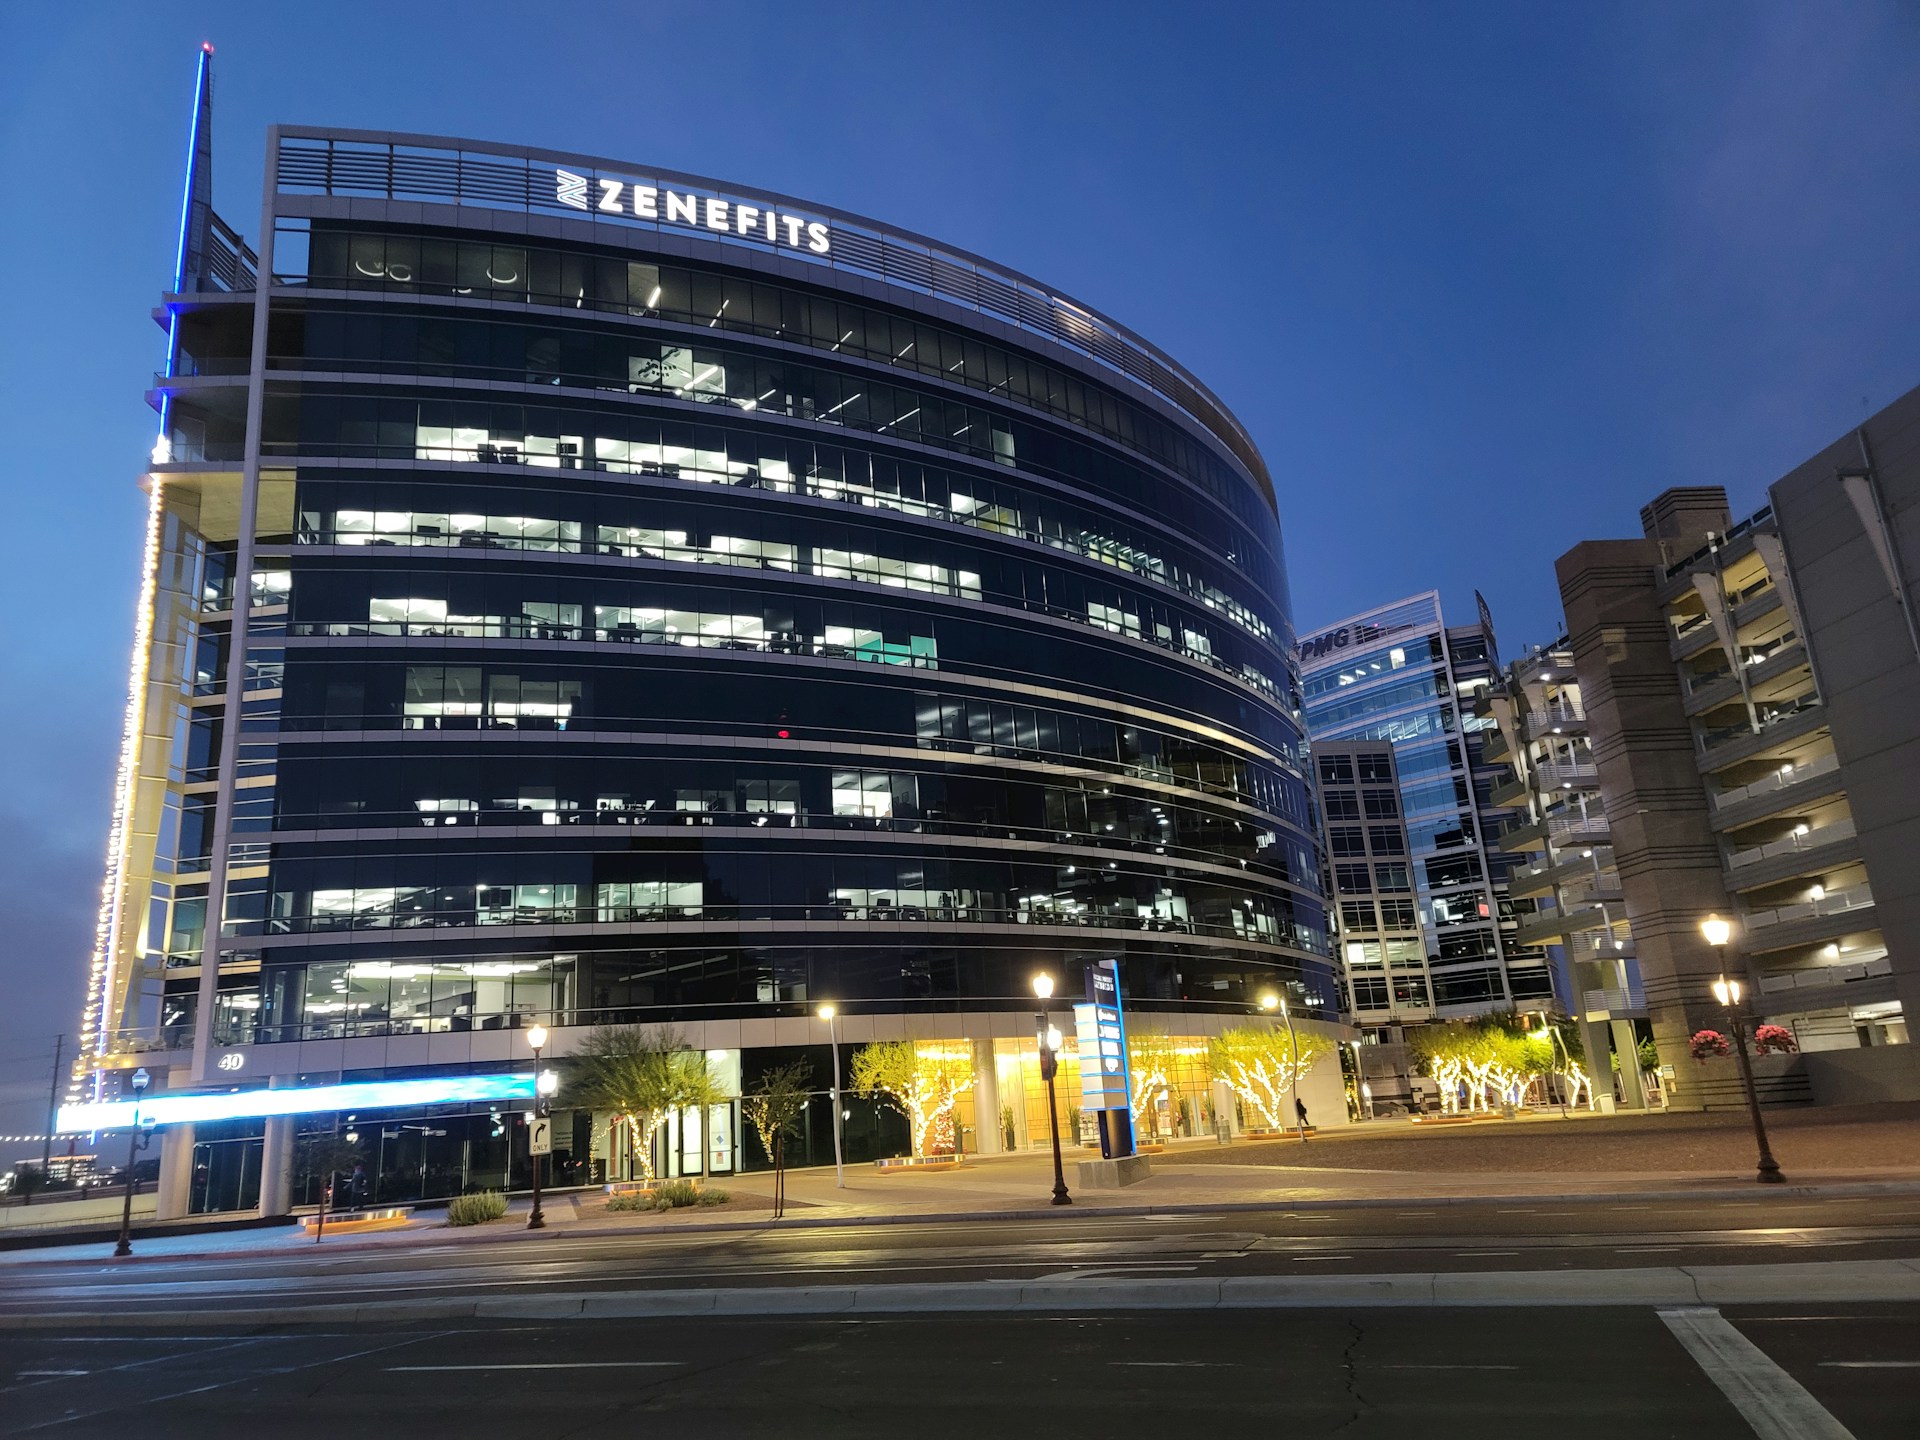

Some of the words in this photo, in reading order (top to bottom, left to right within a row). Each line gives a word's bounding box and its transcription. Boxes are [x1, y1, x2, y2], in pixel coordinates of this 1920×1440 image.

[598, 179, 830, 253] ZENEFITS
[1295, 628, 1350, 662] PMG
[217, 1053, 244, 1071] 40
[532, 1143, 548, 1152] ONLY
